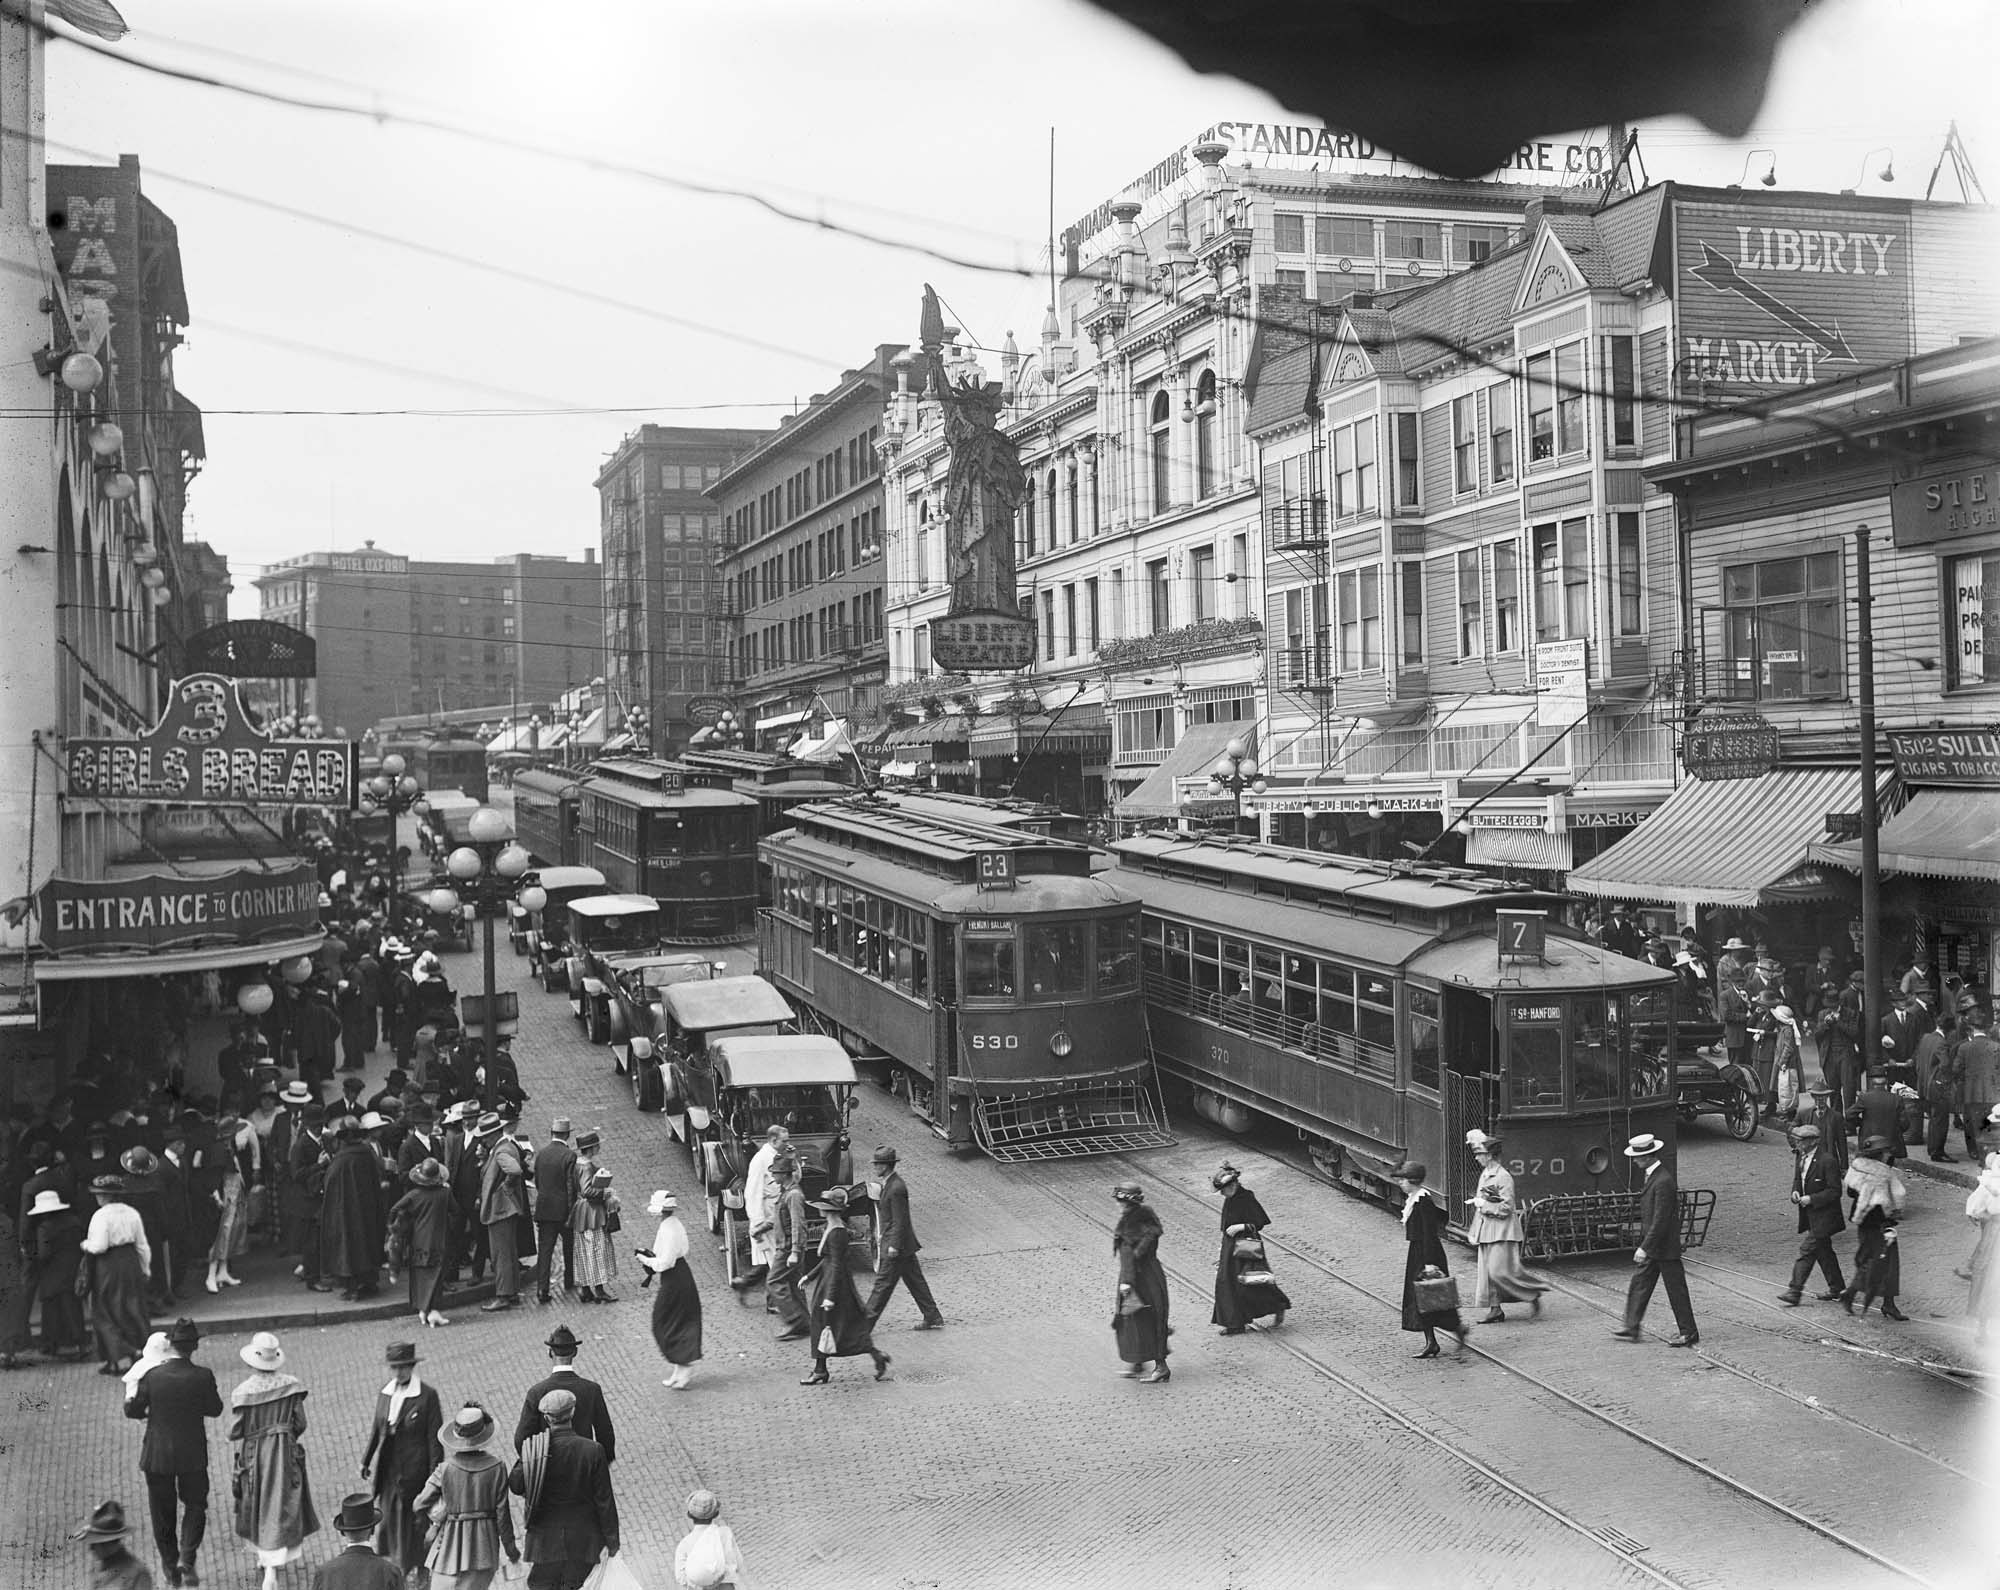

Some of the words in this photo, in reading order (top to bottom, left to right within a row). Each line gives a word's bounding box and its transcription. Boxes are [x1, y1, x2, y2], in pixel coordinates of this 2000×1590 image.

[1217, 121, 1376, 160] STANDARD
[1059, 199, 1114, 257] SNDARD
[1736, 226, 1896, 275] LIBERTY
[1686, 337, 1819, 384] MARKET
[1926, 474, 2000, 510] STE
[937, 622, 1034, 641] LIBERTY
[1539, 677, 1550, 686] FOR
[1551, 675, 1565, 686] RENT
[177, 680, 227, 744] 3
[1894, 736, 1935, 755] 1502
[71, 747, 190, 795] GIRLS
[202, 748, 345, 797] BREAD
[665, 774, 679, 788] 20
[1257, 800, 1299, 812] LIBERTY
[1318, 800, 1360, 811] PUBLIC
[1383, 799, 1439, 811] MARKET
[982, 854, 1008, 878] 23
[56, 894, 208, 931] ENTRANCE
[213, 899, 226, 913] TO
[230, 887, 295, 919] CORNER
[1512, 922, 1528, 949] 7
[1530, 1007, 1561, 1019] HANFORD
[972, 1035, 1019, 1049] 530
[1211, 1045, 1230, 1064] 370
[1508, 1158, 1565, 1176] 370
